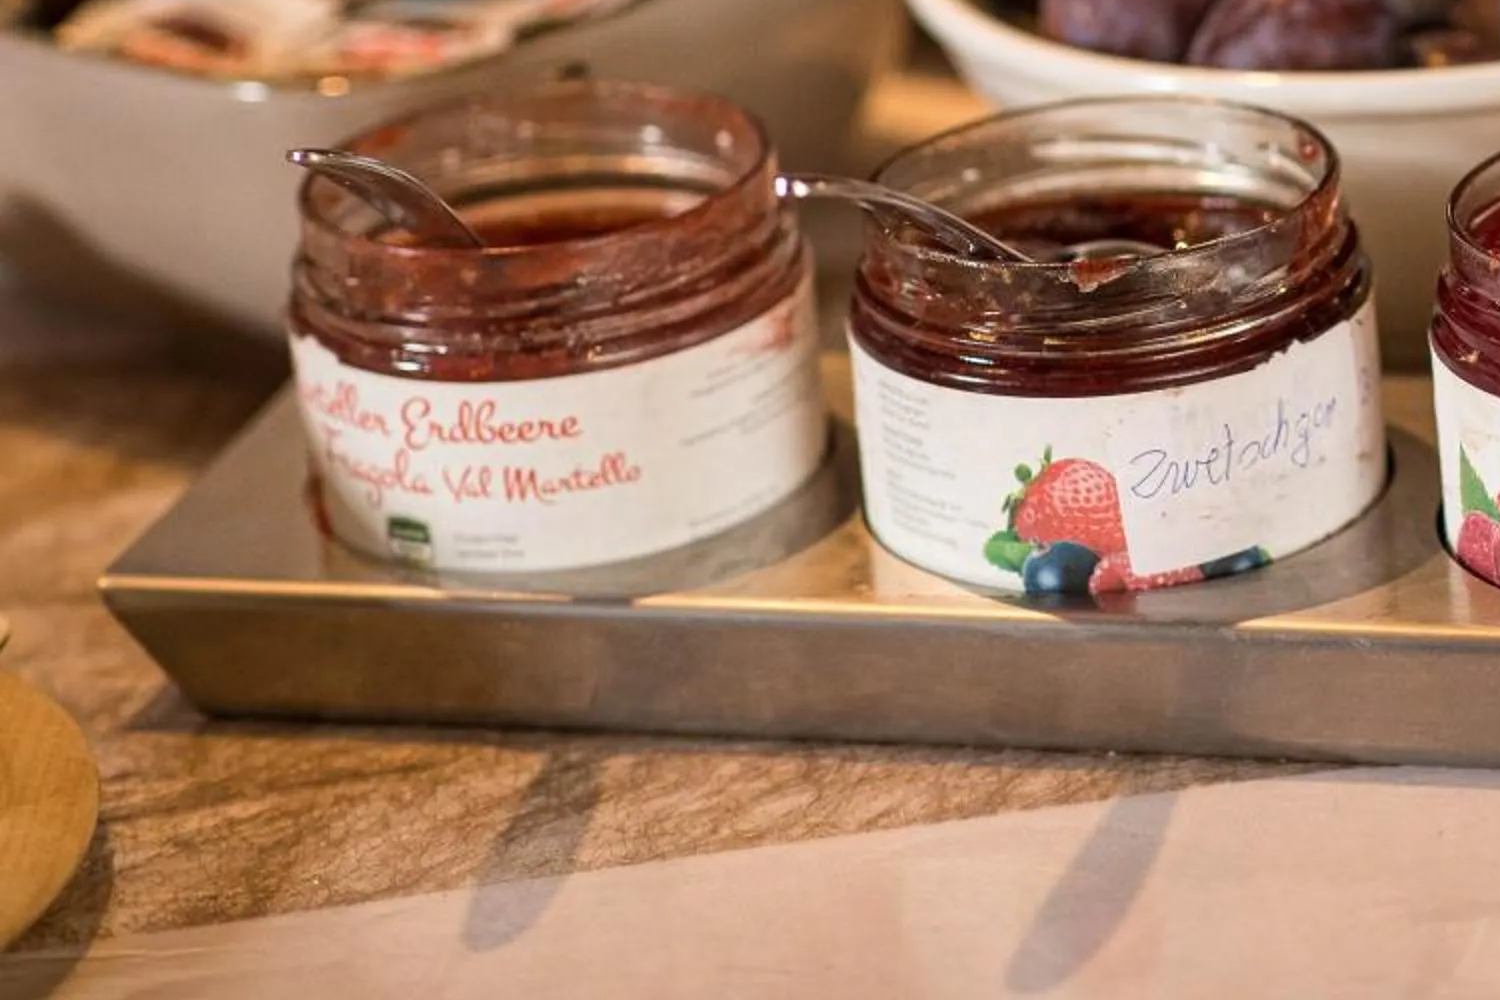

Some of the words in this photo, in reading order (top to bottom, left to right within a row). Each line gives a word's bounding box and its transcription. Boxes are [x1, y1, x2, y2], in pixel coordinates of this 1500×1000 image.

[400, 395, 583, 450] Erdbeere
[442, 464, 493, 503] Val
[502, 450, 643, 506] Martello
